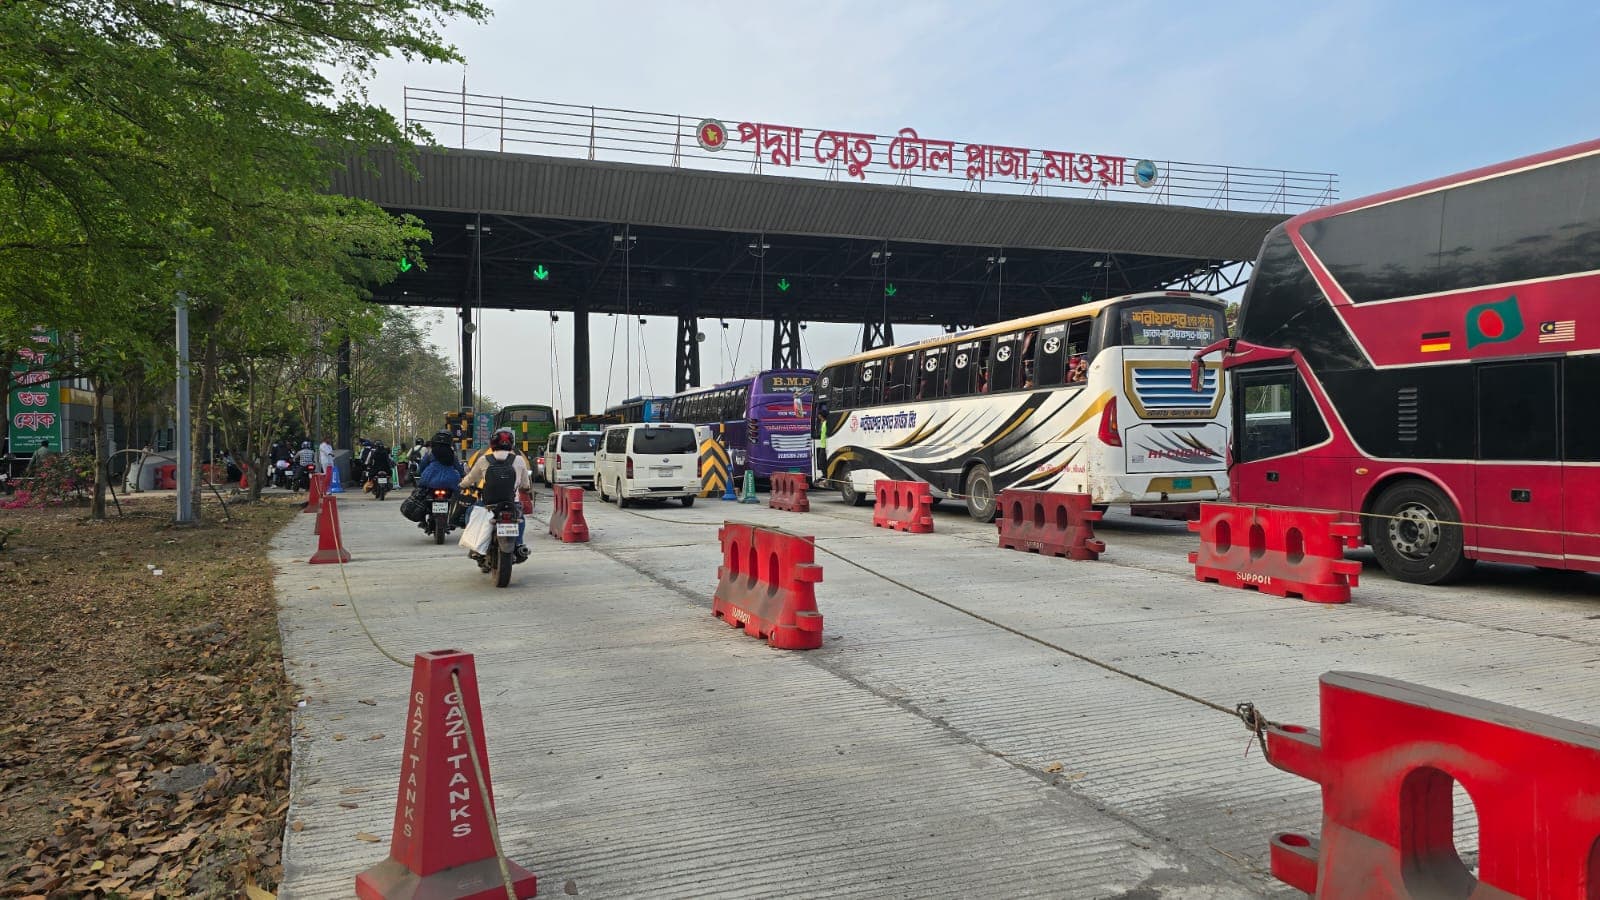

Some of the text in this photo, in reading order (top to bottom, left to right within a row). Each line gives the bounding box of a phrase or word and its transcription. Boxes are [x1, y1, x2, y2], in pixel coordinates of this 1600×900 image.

[737, 121, 803, 168] পদ্মা
[814, 130, 877, 181] সেতু
[888, 127, 955, 174] টোল
[14, 410, 56, 432] হোক
[17, 391, 49, 407] শুভ
[412, 690, 424, 749] GAZI
[402, 754, 420, 838] TANKS
[447, 754, 473, 839] TANKS
